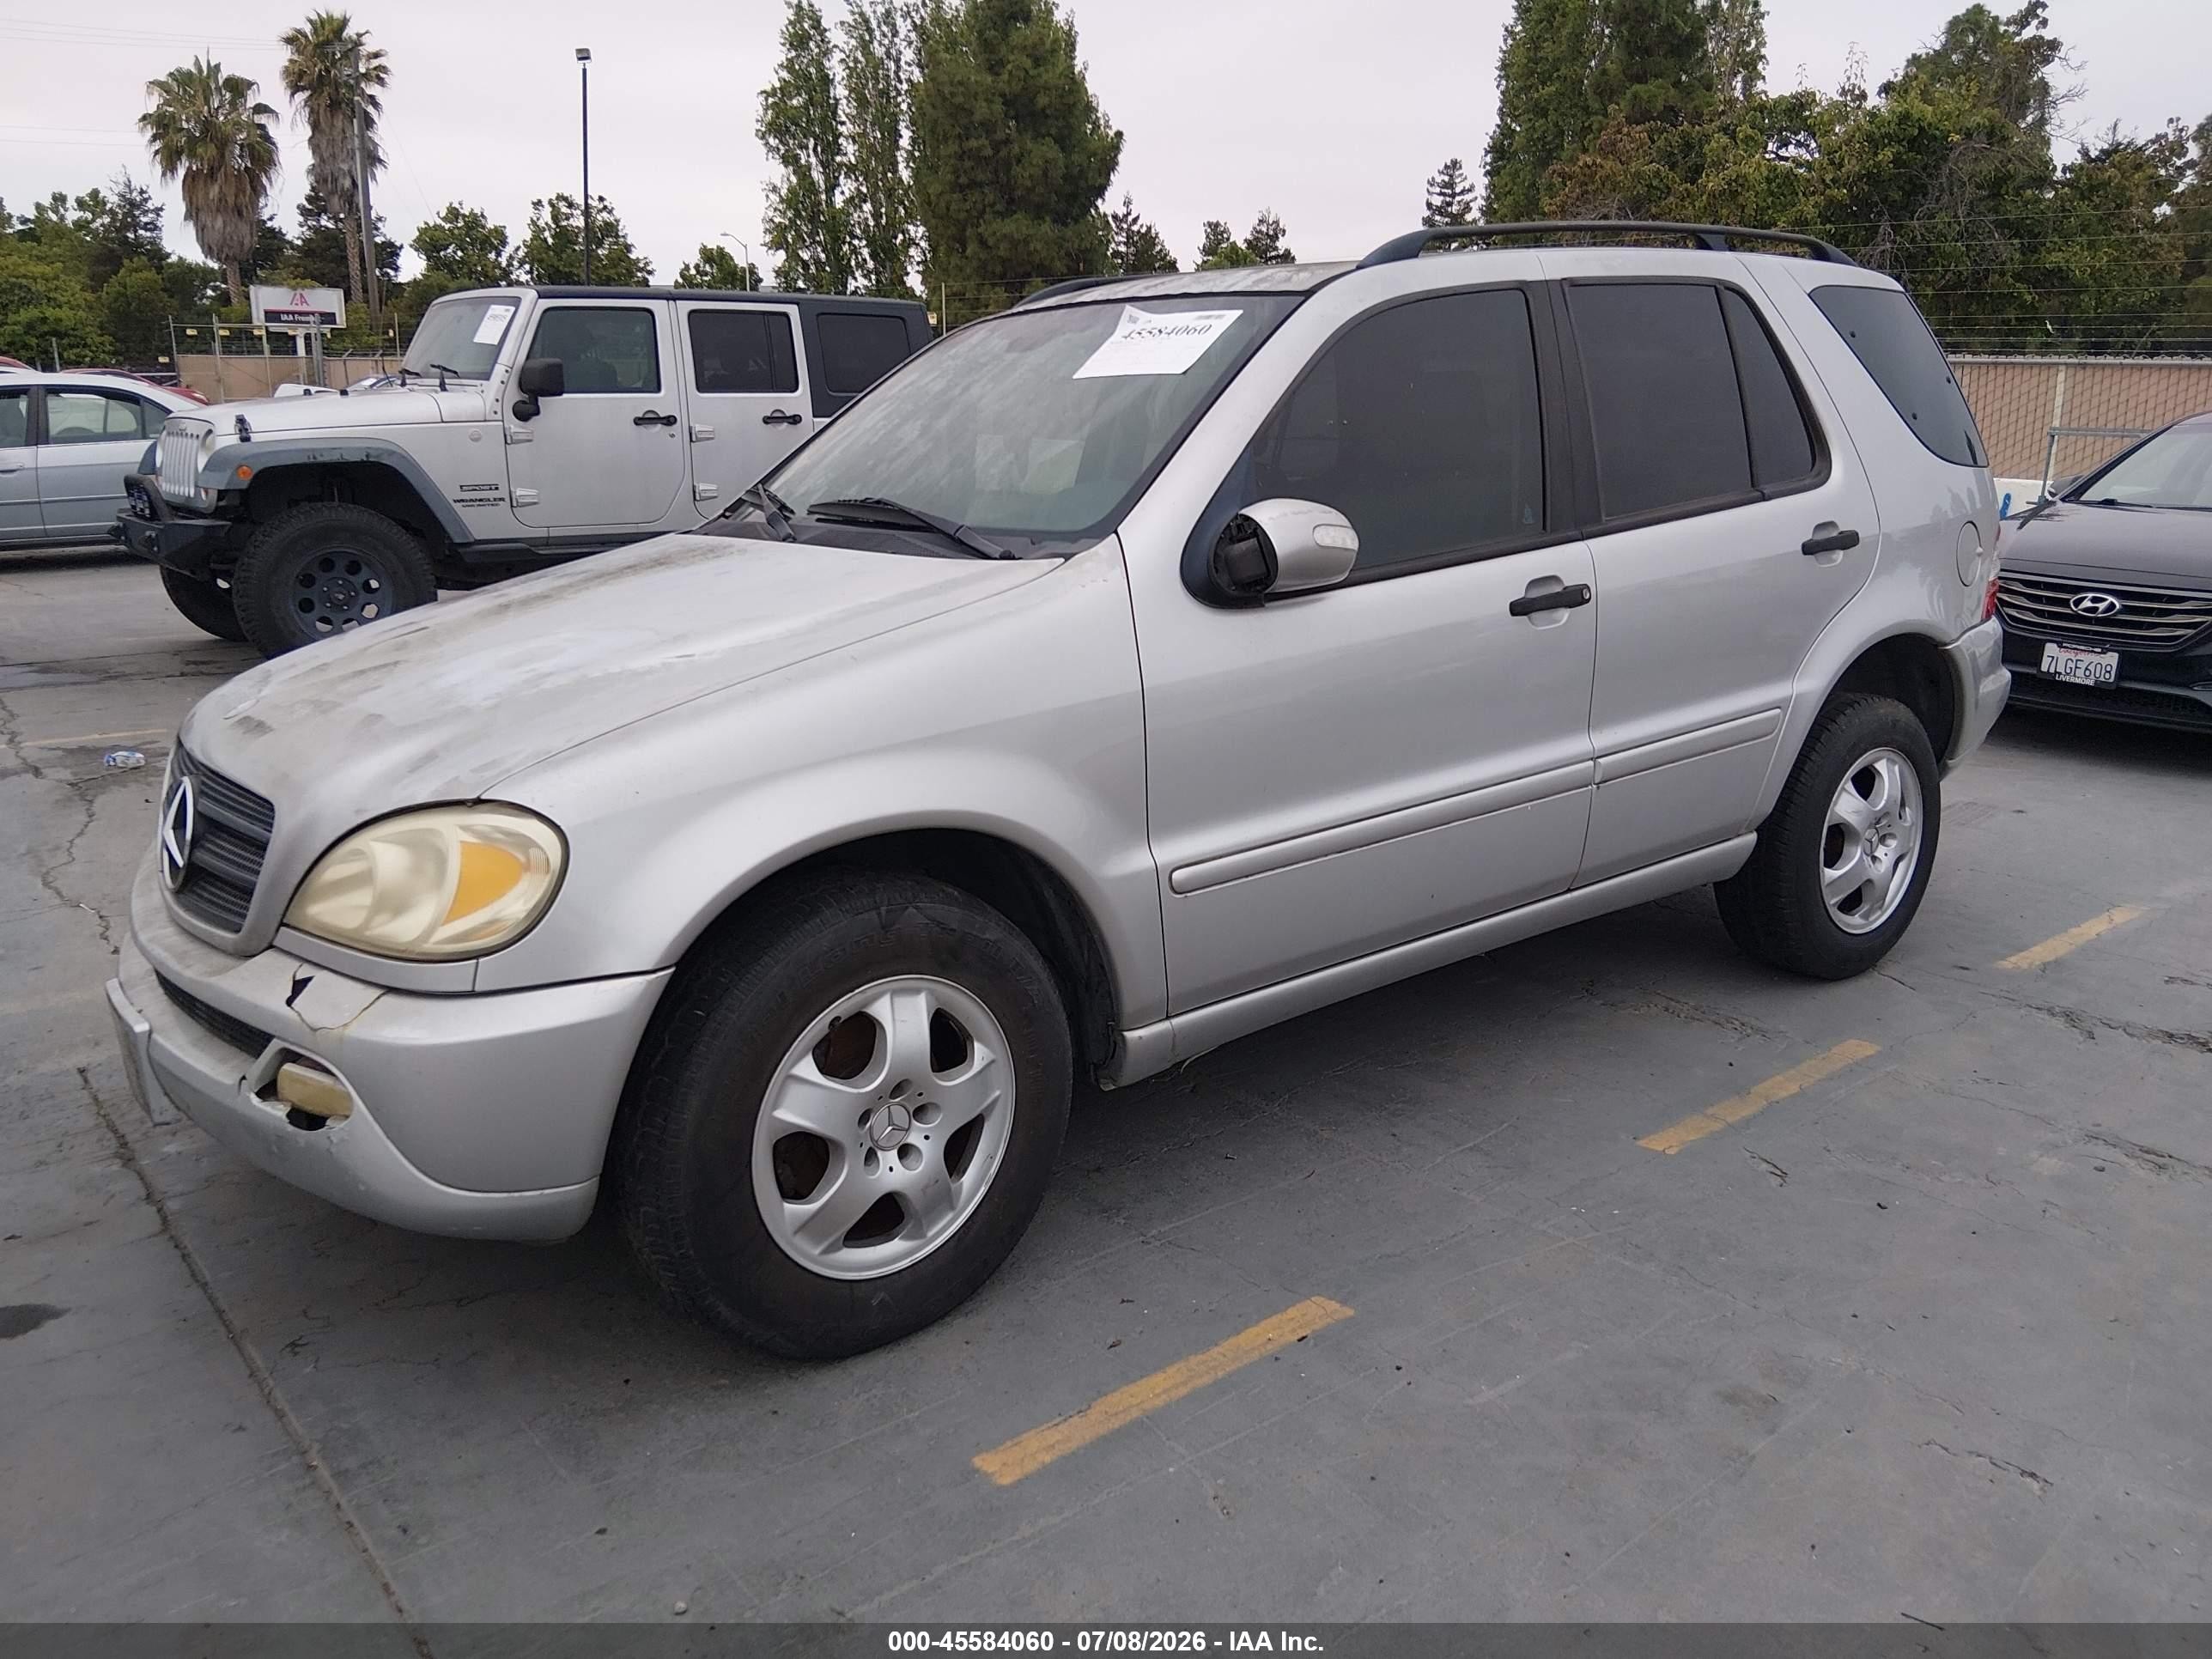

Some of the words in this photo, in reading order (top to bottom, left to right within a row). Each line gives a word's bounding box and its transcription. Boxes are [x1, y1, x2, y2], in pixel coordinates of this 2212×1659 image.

[1121, 324, 1212, 340] 45584060
[2046, 654, 2113, 680] 7LGF608
[2055, 673, 2095, 686] LIVERMORE
